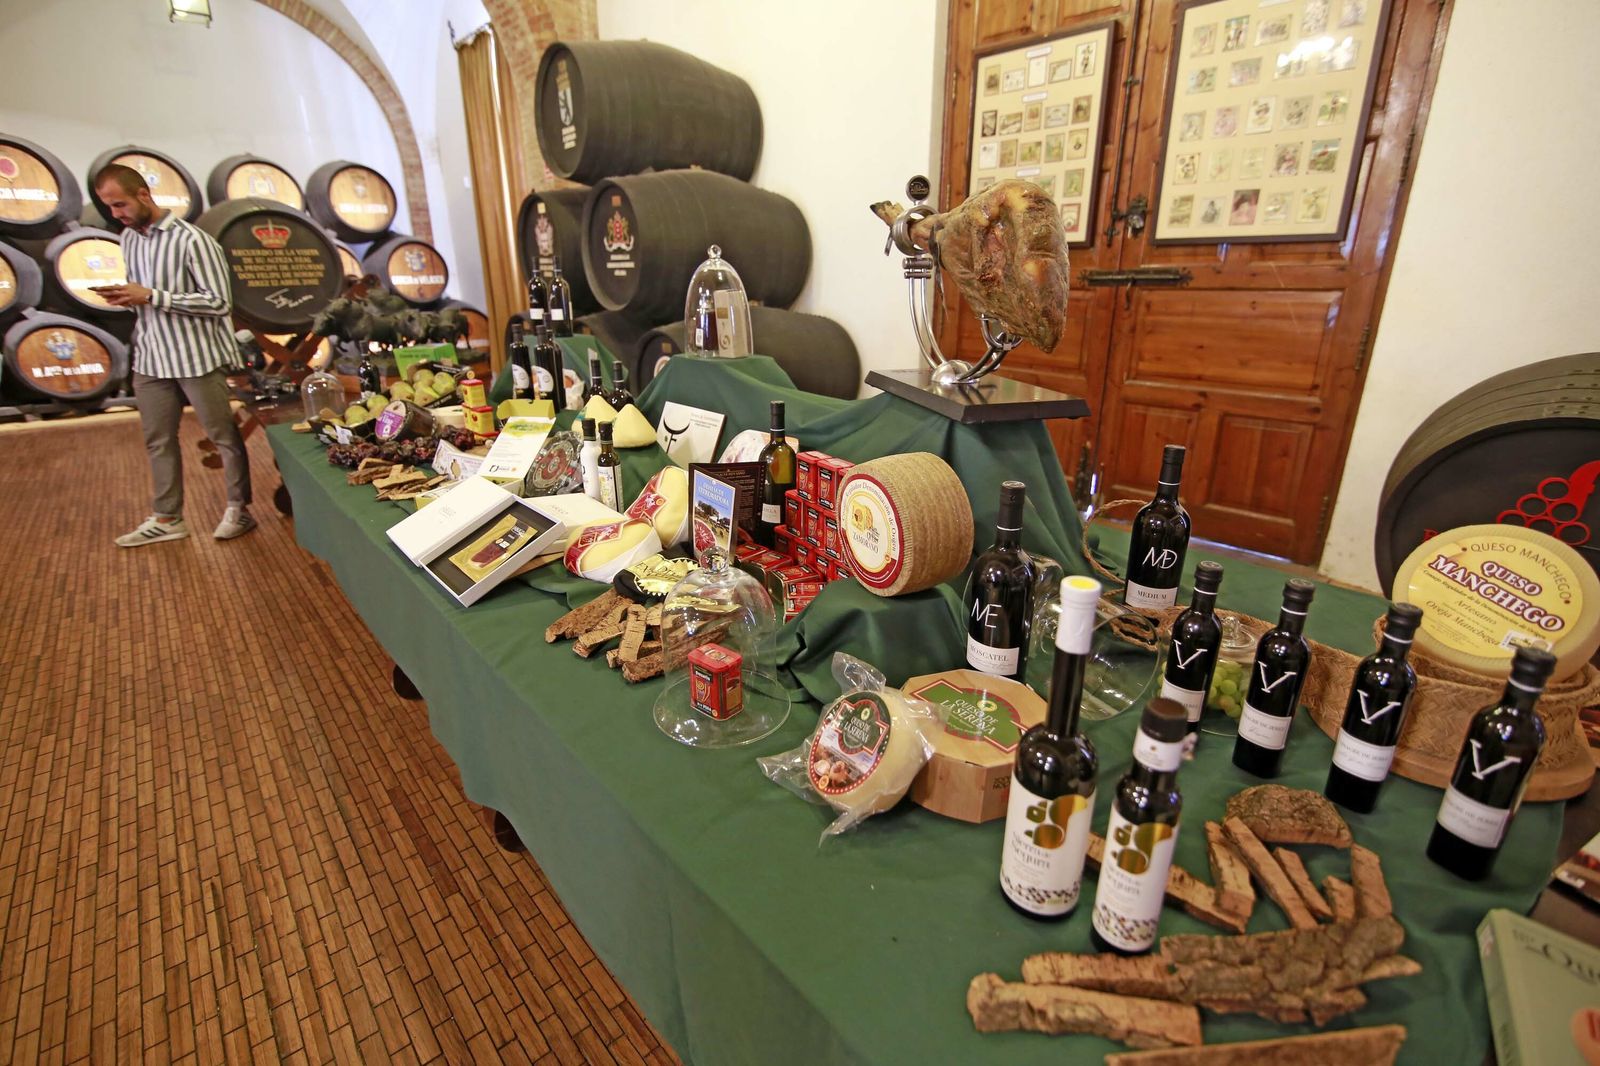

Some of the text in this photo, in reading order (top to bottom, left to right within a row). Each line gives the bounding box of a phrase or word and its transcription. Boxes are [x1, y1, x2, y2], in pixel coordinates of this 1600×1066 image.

[1470, 544, 1572, 600] QUESO MANCHEGO
[1481, 560, 1542, 596] QUESO
[1138, 590, 1166, 600] MEDIUM
[1426, 600, 1452, 618] Oveja
[1428, 554, 1565, 632] MANCHEGO
[970, 598, 1002, 628] ME
[1454, 600, 1497, 626] Artesano
[971, 644, 1009, 662] MOSCATEL
[1174, 639, 1208, 670] V
[1258, 660, 1297, 694] V
[940, 700, 996, 734] LA SERENA
[956, 699, 998, 725] QUESO DE
[1357, 689, 1402, 725] V
[1470, 738, 1522, 780] V
